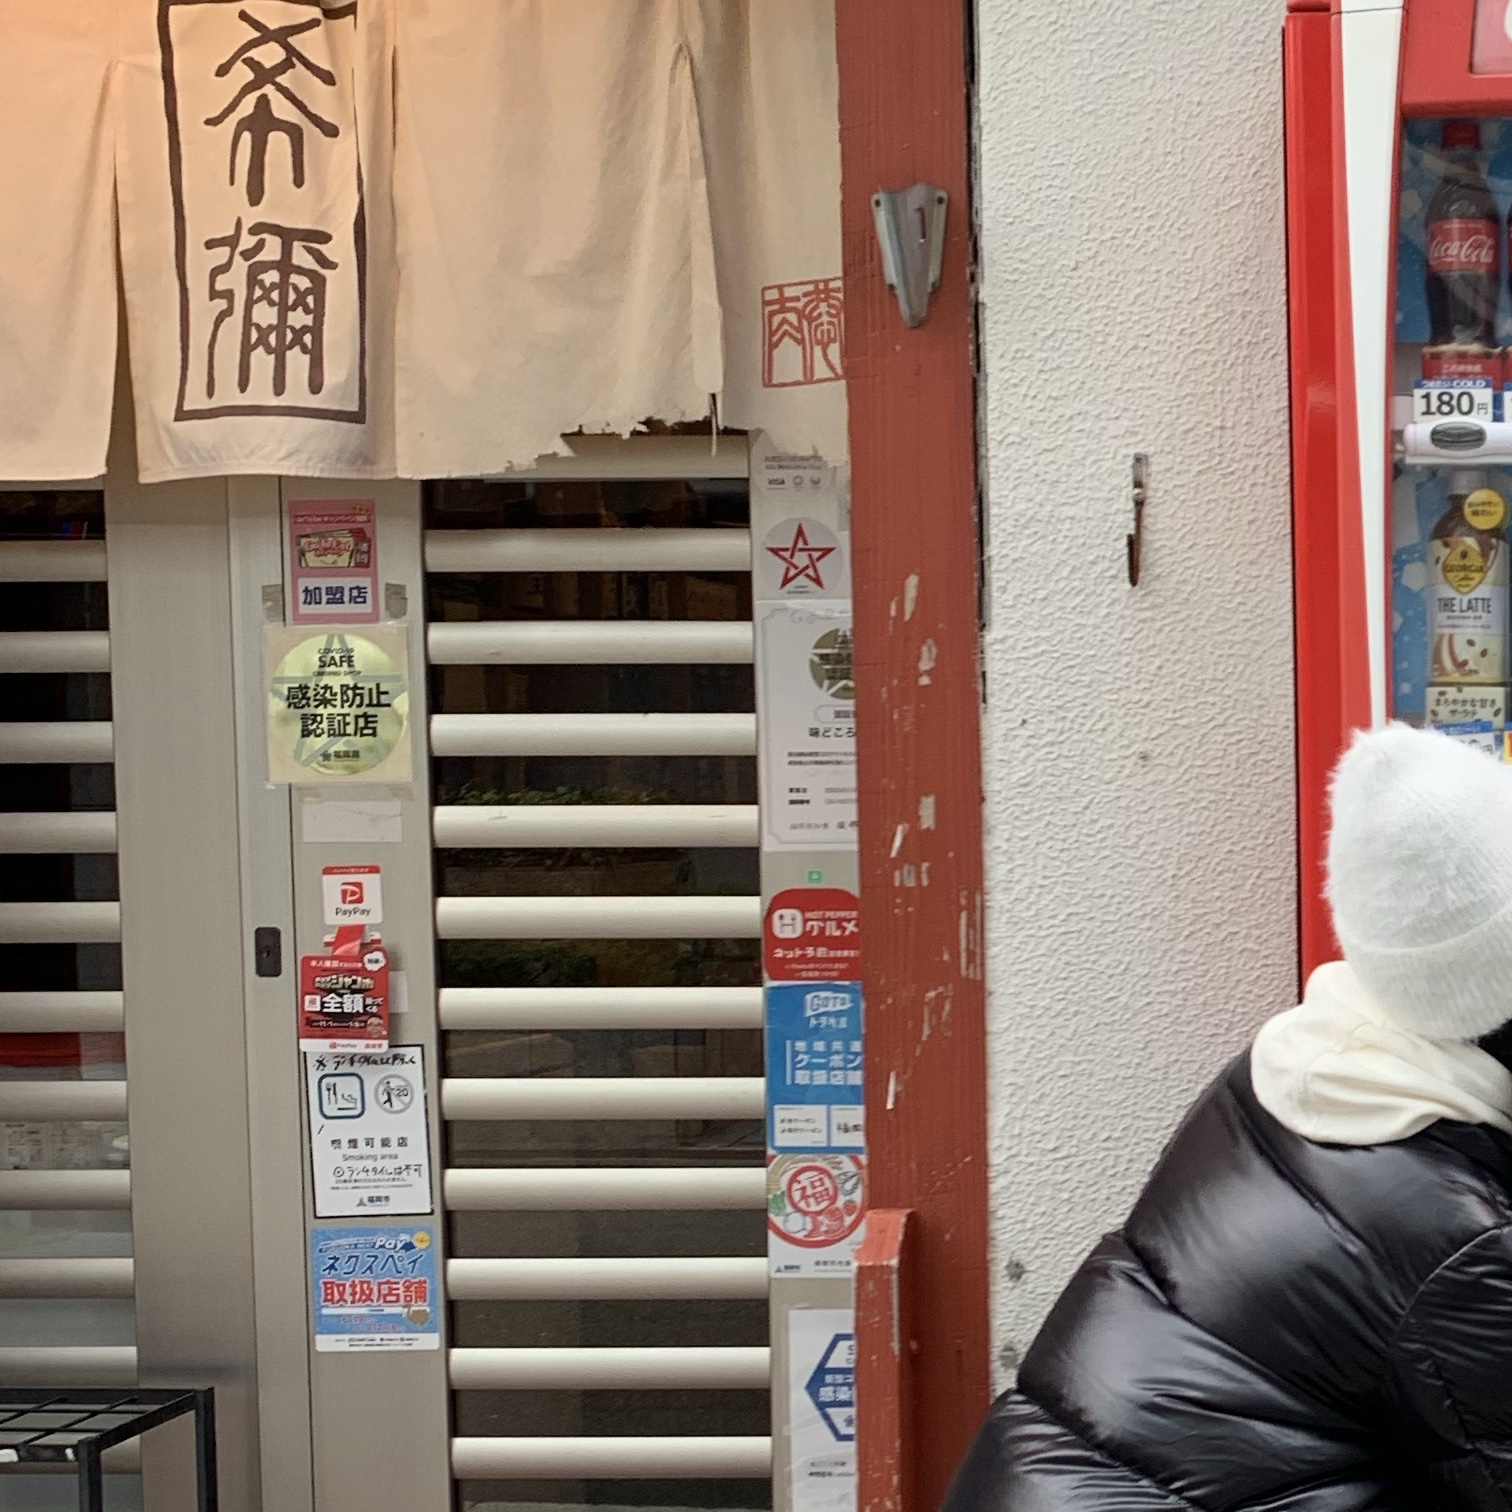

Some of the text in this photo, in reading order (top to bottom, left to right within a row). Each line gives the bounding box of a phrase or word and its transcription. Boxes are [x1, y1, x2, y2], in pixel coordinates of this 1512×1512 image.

[1420, 391, 1489, 416] 180円
[302, 585, 368, 606] 加盟店
[1437, 597, 1492, 614] THE LATTE
[317, 655, 355, 669] SAFE
[285, 682, 392, 709] 感染防止
[299, 713, 379, 739] 認証店
[335, 906, 372, 918] PayPay
[805, 920, 860, 938] グルメ
[321, 993, 365, 1014] 全額
[794, 1054, 863, 1069] クーポン
[793, 1173, 831, 1209] 福
[373, 1236, 407, 1251] Pay
[321, 1254, 424, 1276] ネクスペイ
[320, 1279, 429, 1306] 取扱店舗
